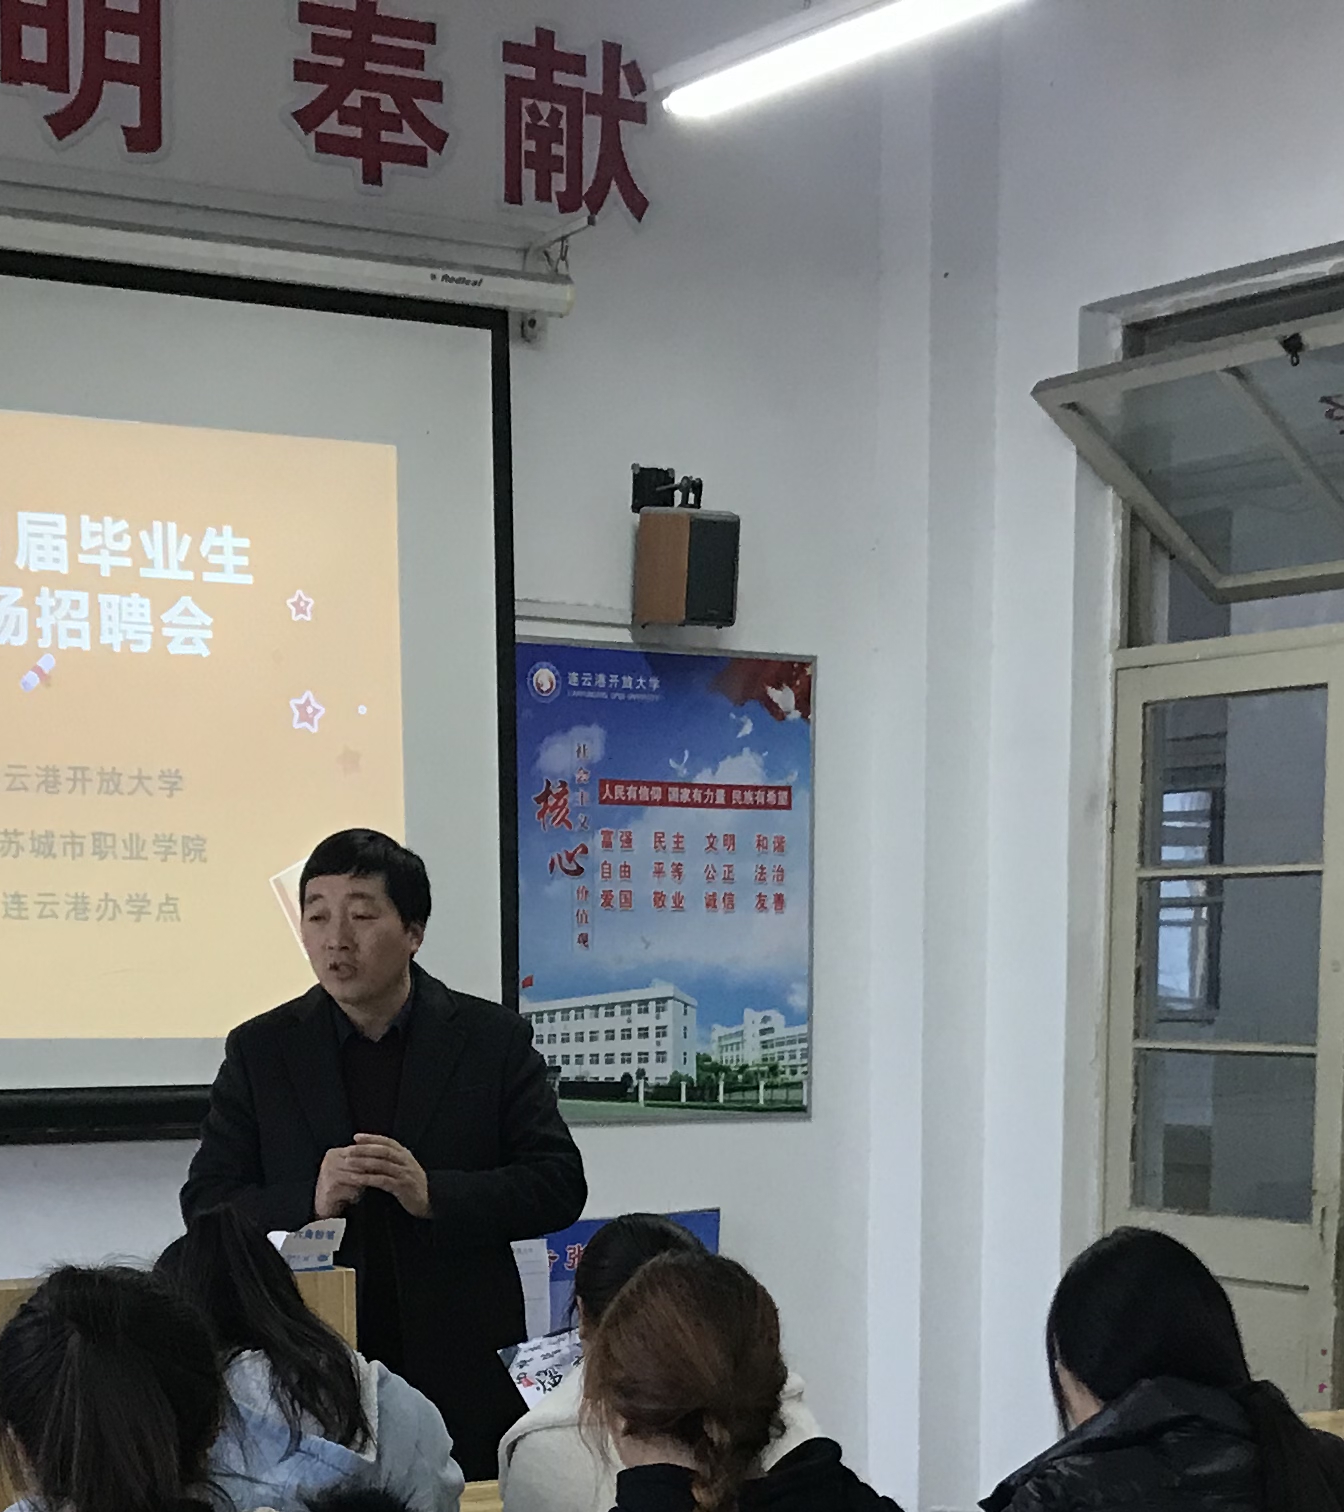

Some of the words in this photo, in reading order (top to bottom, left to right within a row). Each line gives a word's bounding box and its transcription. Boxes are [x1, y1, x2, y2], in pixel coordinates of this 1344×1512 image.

[292, 0, 650, 222] 奉献
[602, 784, 663, 802] 人民有信仰
[667, 786, 726, 805] 国家有力量
[731, 789, 789, 807] 民族有希望
[600, 829, 633, 850] 富强
[653, 831, 685, 851] 民主
[705, 832, 737, 852] 文明
[755, 833, 786, 853] 和谐
[600, 859, 632, 881] 自由
[652, 862, 684, 882] 平等
[704, 864, 735, 882] 公正
[754, 864, 785, 883] 法治
[0, 890, 183, 925] 连云港办学点
[600, 889, 633, 910] 爱国
[652, 890, 685, 910] 敬业
[704, 891, 735, 911] 诚信
[754, 892, 786, 912] 友善
